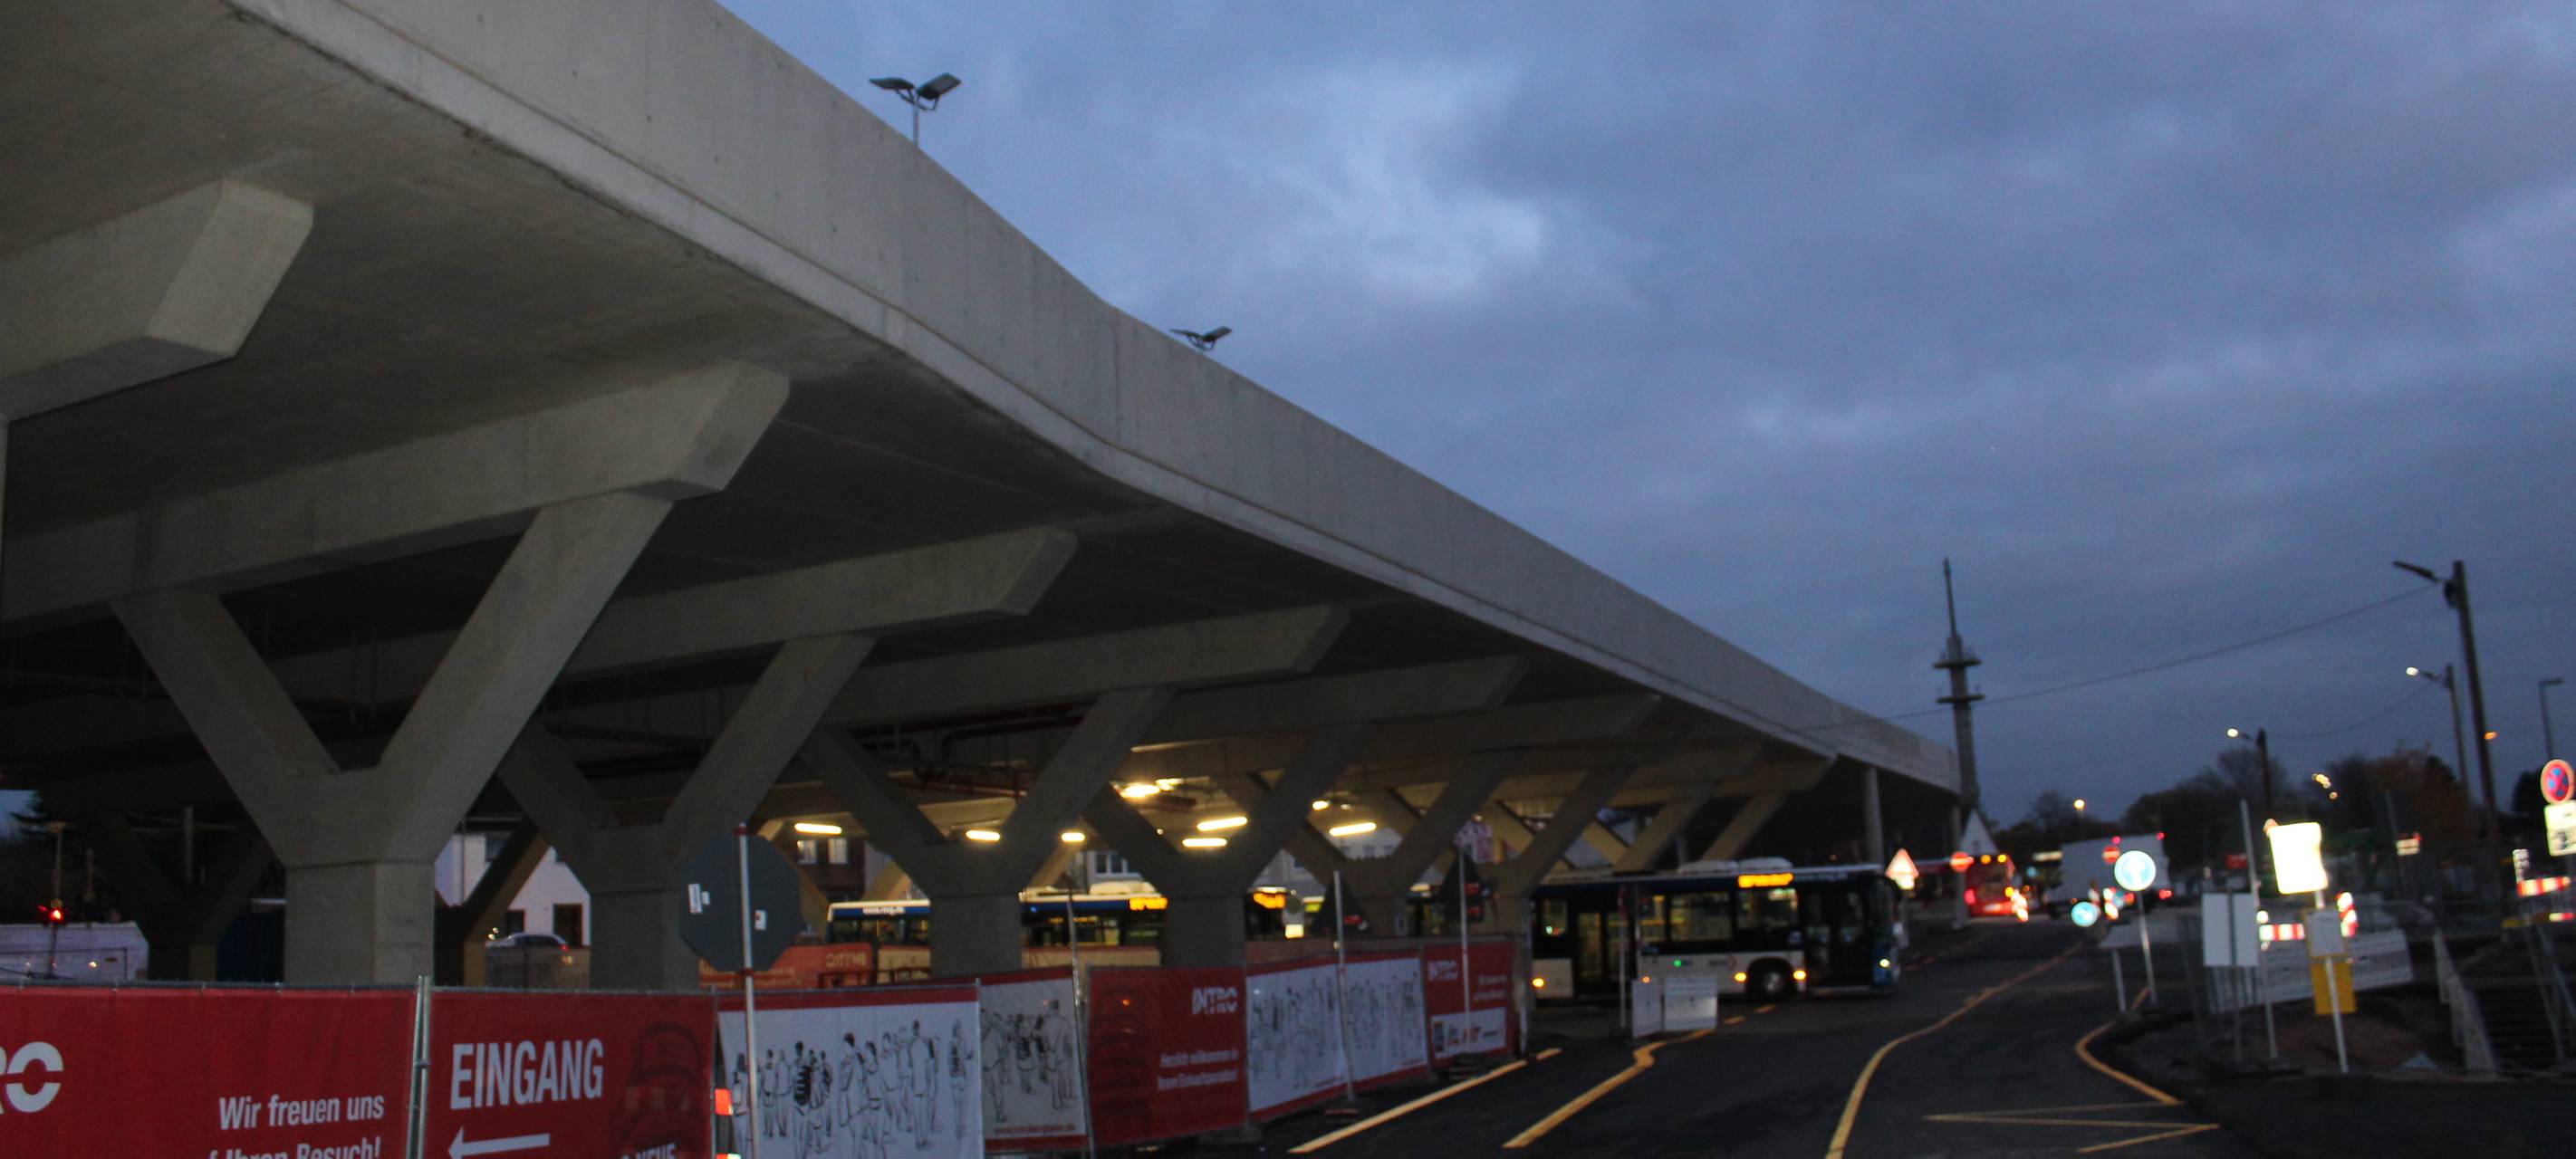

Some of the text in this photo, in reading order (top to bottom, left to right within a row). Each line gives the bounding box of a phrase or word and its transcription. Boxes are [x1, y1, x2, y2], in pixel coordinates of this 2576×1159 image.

[1192, 986, 1238, 1014] INTRO
[450, 1039, 604, 1110] EINGANG
[219, 1094, 386, 1131] Wir freuen uns
